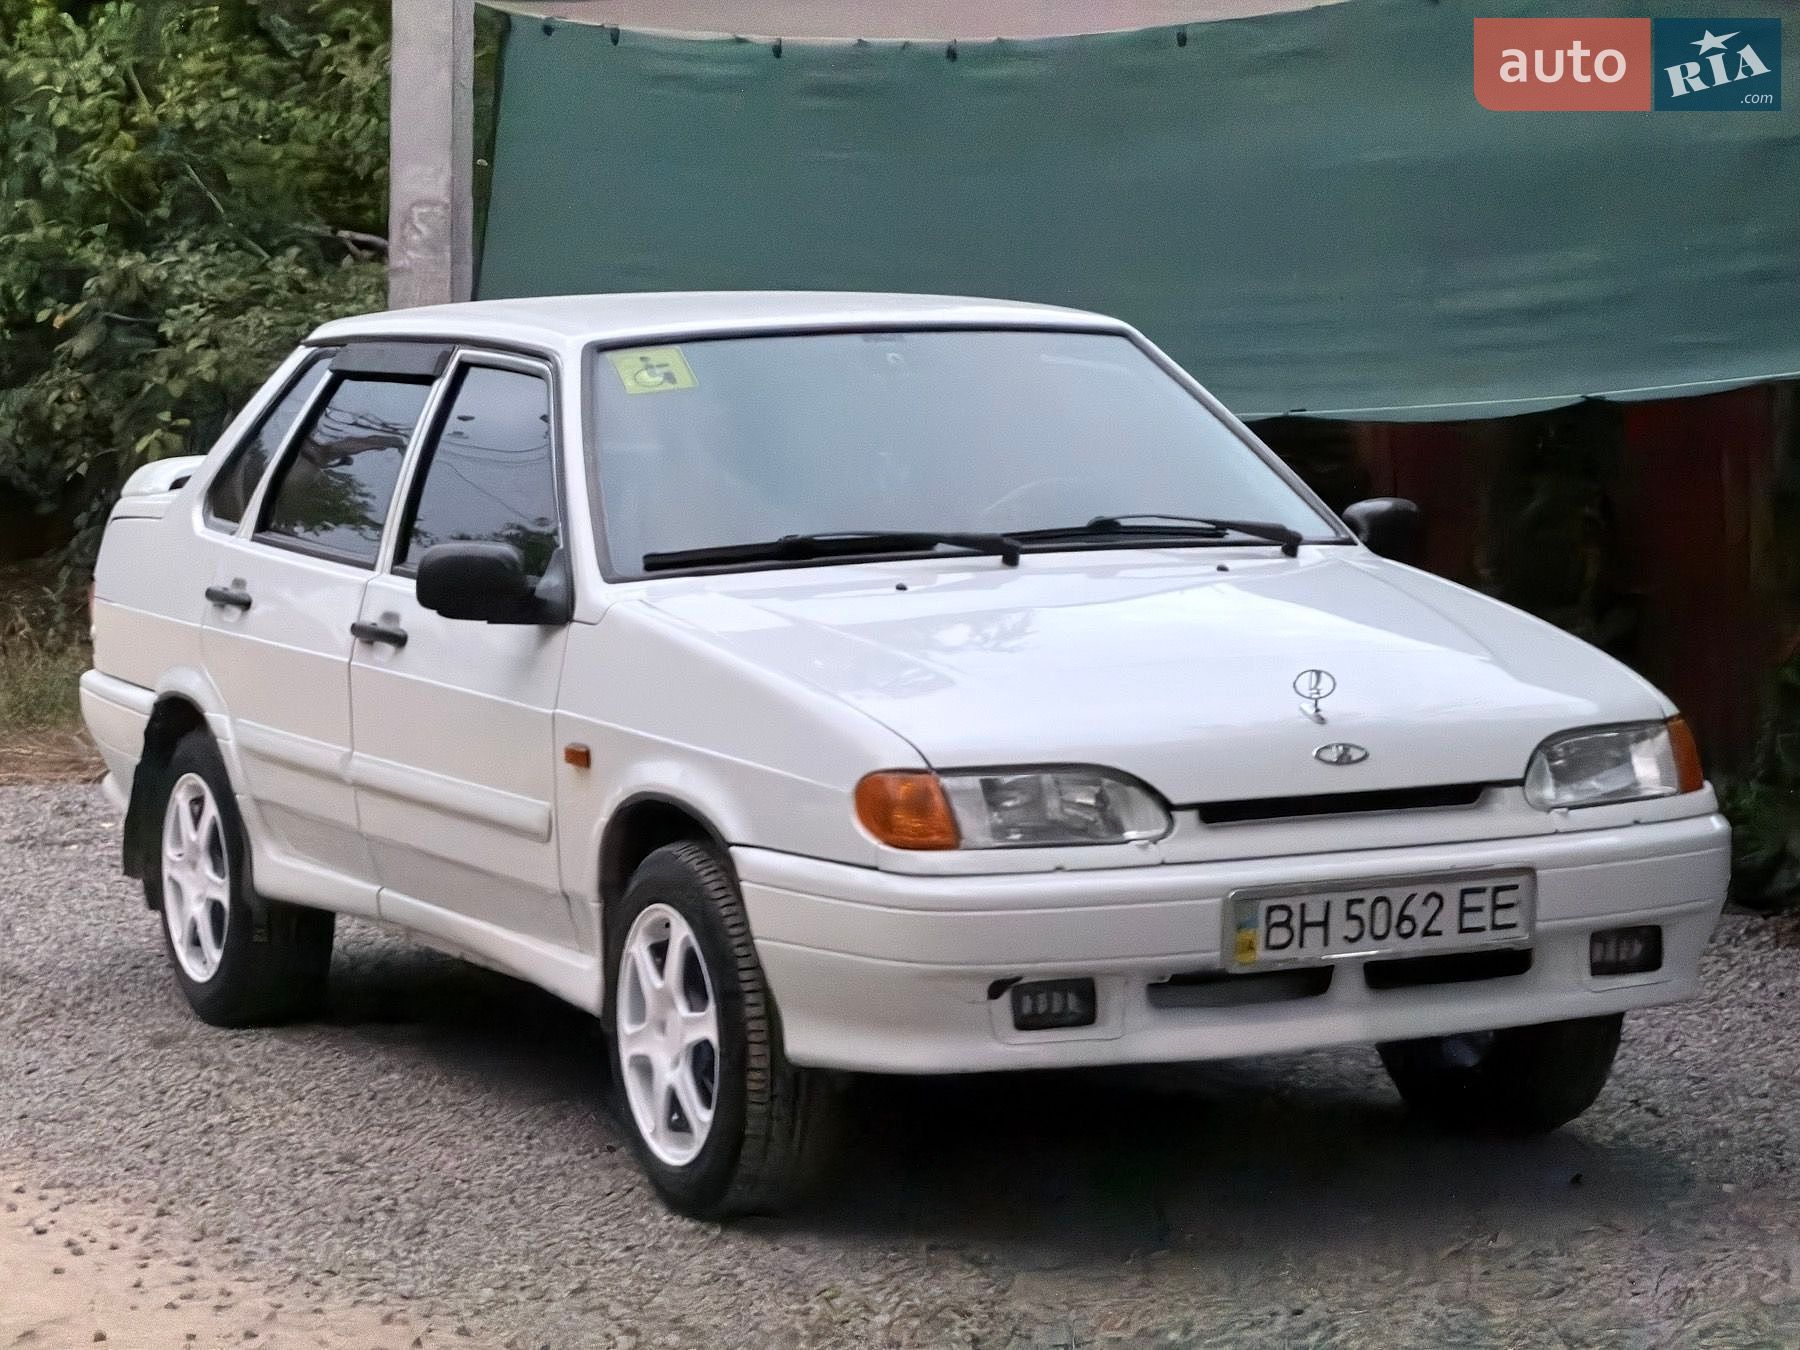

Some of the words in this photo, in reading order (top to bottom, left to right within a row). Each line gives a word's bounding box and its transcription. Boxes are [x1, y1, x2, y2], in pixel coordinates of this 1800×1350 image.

[1264, 901, 1331, 951] BH
[1342, 891, 1444, 944] 5062
[1457, 883, 1520, 934] EE
